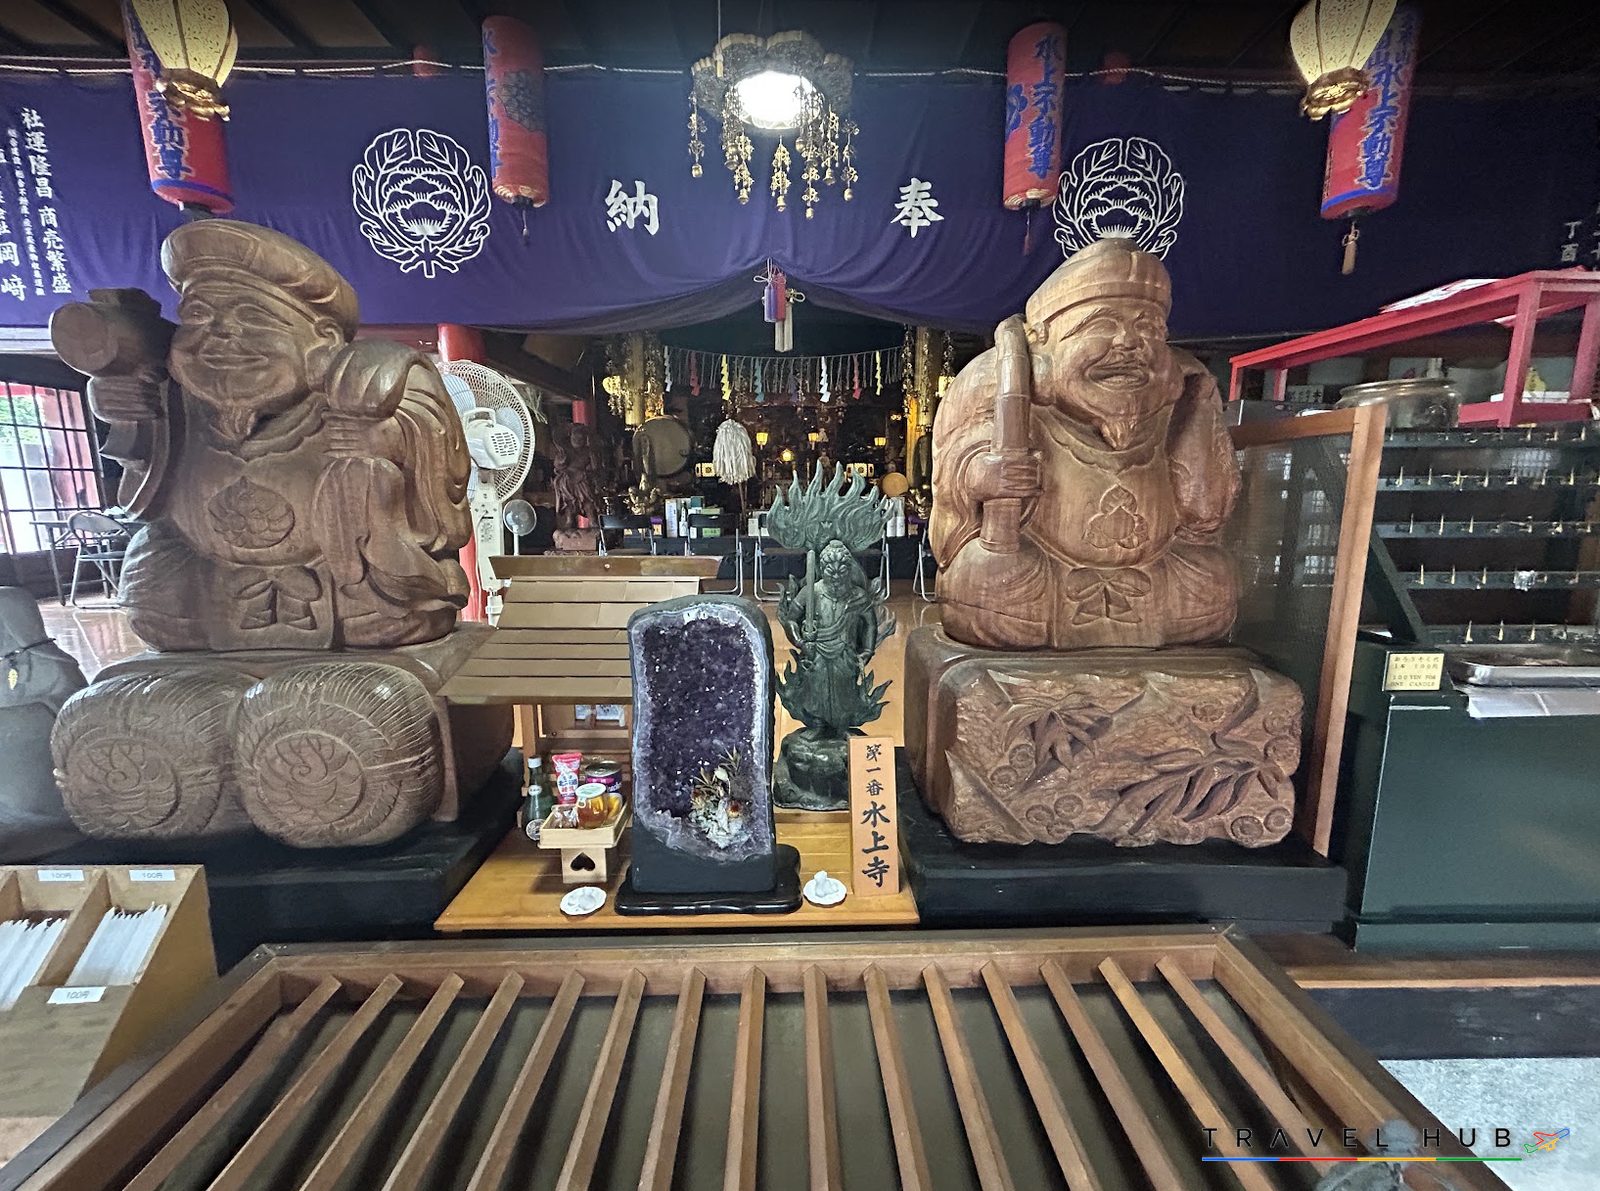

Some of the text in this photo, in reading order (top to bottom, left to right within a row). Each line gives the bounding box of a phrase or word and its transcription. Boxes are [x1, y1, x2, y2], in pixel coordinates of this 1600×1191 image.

[605, 177, 944, 238] 奉 納
[66, 990, 90, 999] 100円
